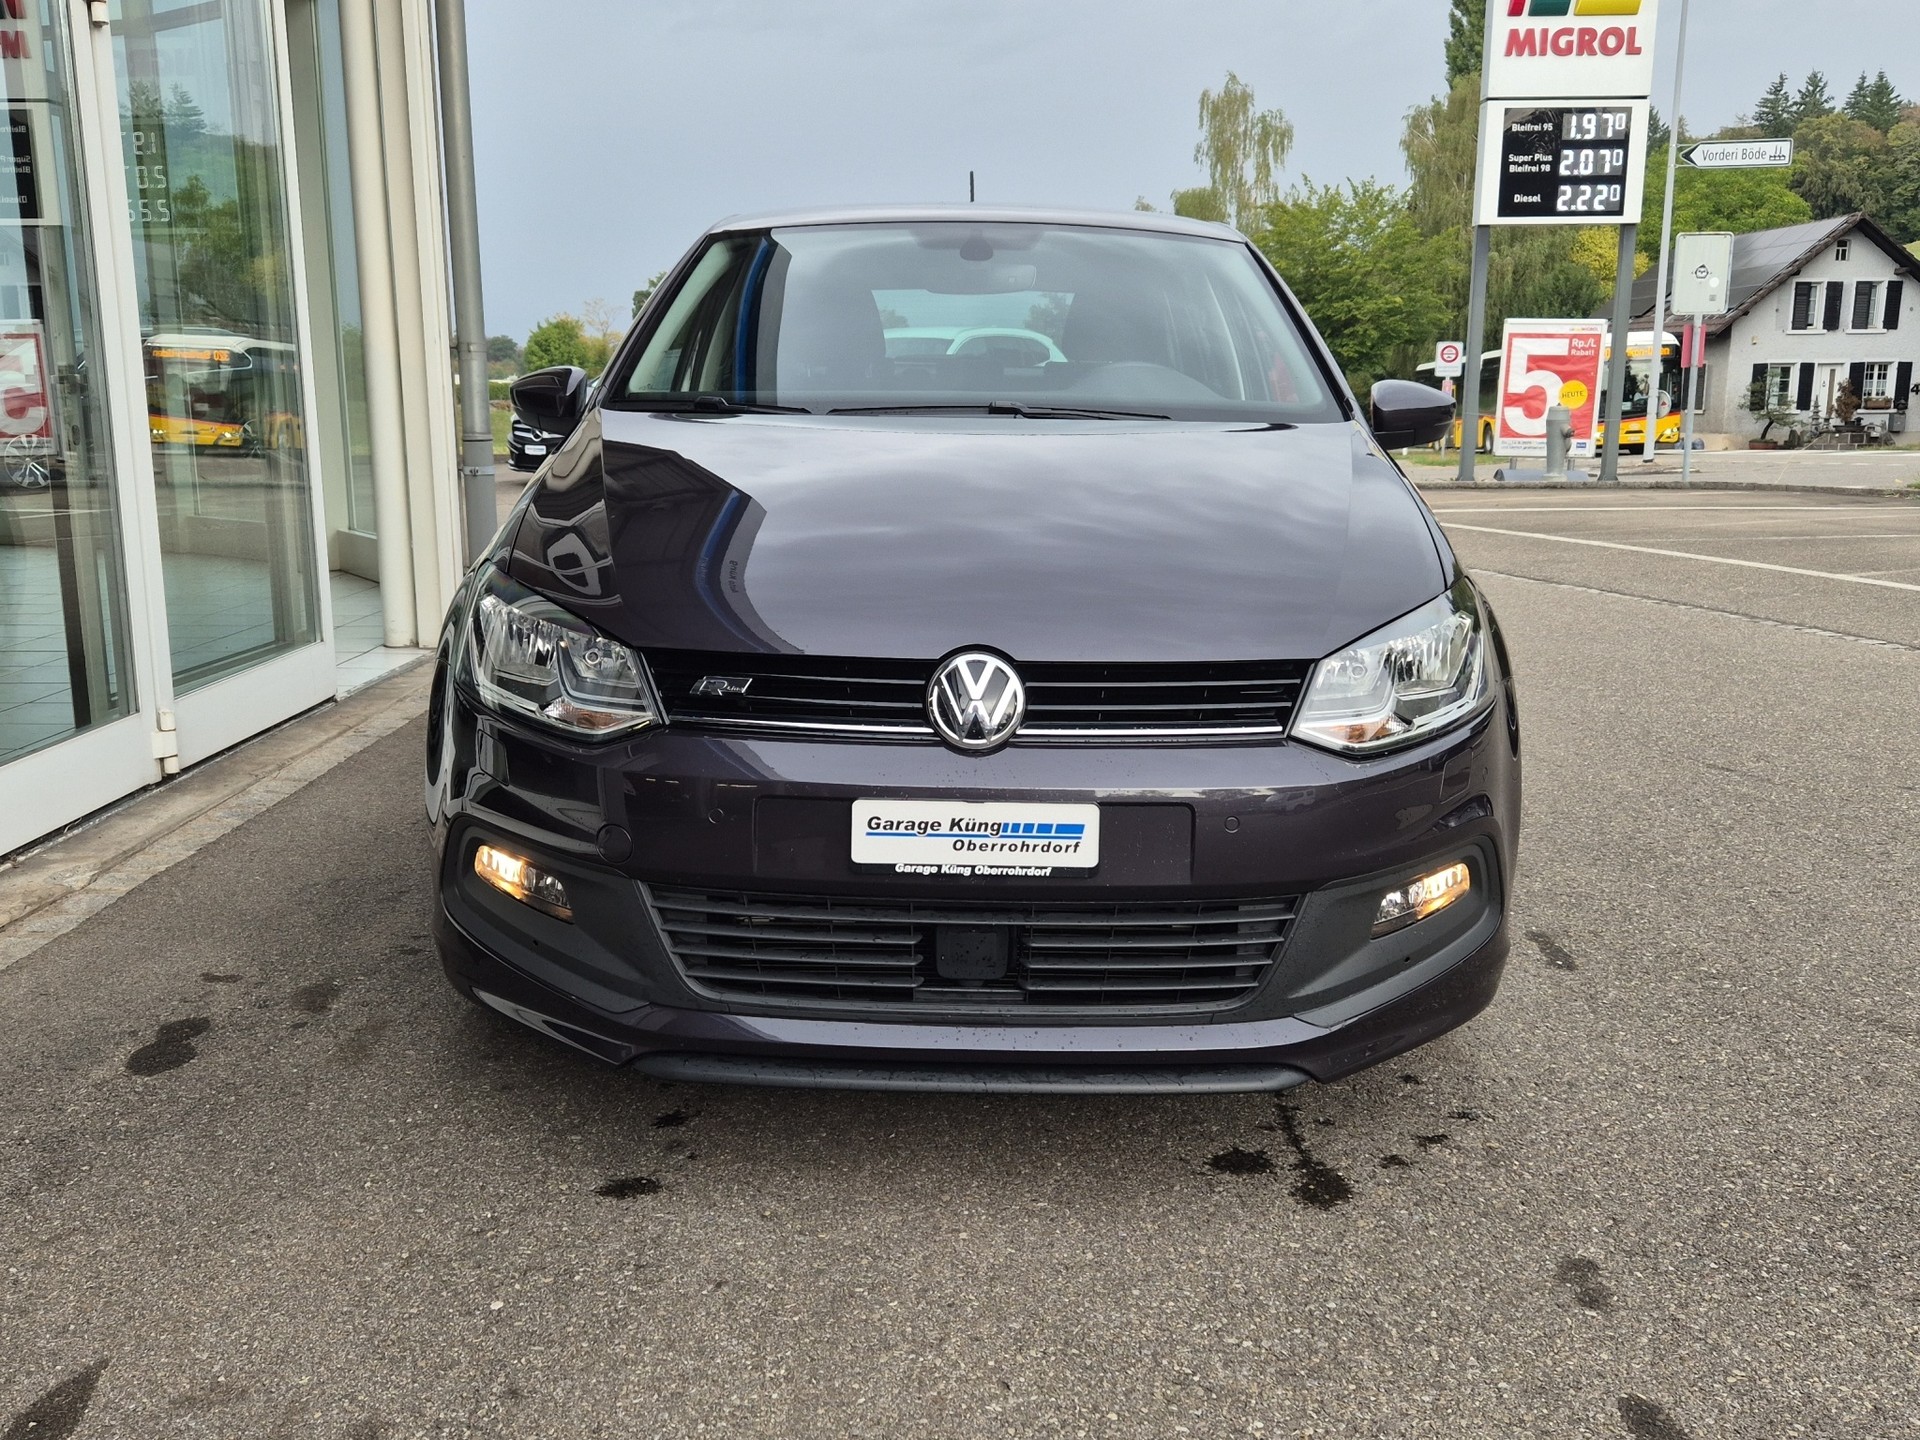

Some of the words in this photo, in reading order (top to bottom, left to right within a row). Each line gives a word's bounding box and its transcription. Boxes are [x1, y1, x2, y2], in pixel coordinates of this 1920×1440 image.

[1504, 27, 1642, 57] MIGROL
[1511, 123, 1542, 132] Bleifrei
[1543, 123, 1553, 132] 95
[1508, 154, 1533, 163] Super
[1534, 153, 1553, 162] Plus
[1702, 148, 1738, 161] Vorderi
[1741, 147, 1767, 160] Böde
[1509, 164, 1539, 173] Bleifrei
[1540, 164, 1551, 172] 98
[1513, 194, 1541, 203] Diesel
[1570, 348, 1595, 356] Rabatt
[1503, 337, 1570, 436] 5
[1561, 390, 1584, 400] HEUTE
[867, 816, 942, 836] Garage
[949, 817, 1002, 837] Küng
[952, 839, 1081, 854] Oberrohrdorf
[895, 863, 938, 876] Garage
[941, 865, 972, 876] Küng
[974, 865, 1052, 877] Oberrohrdorf
